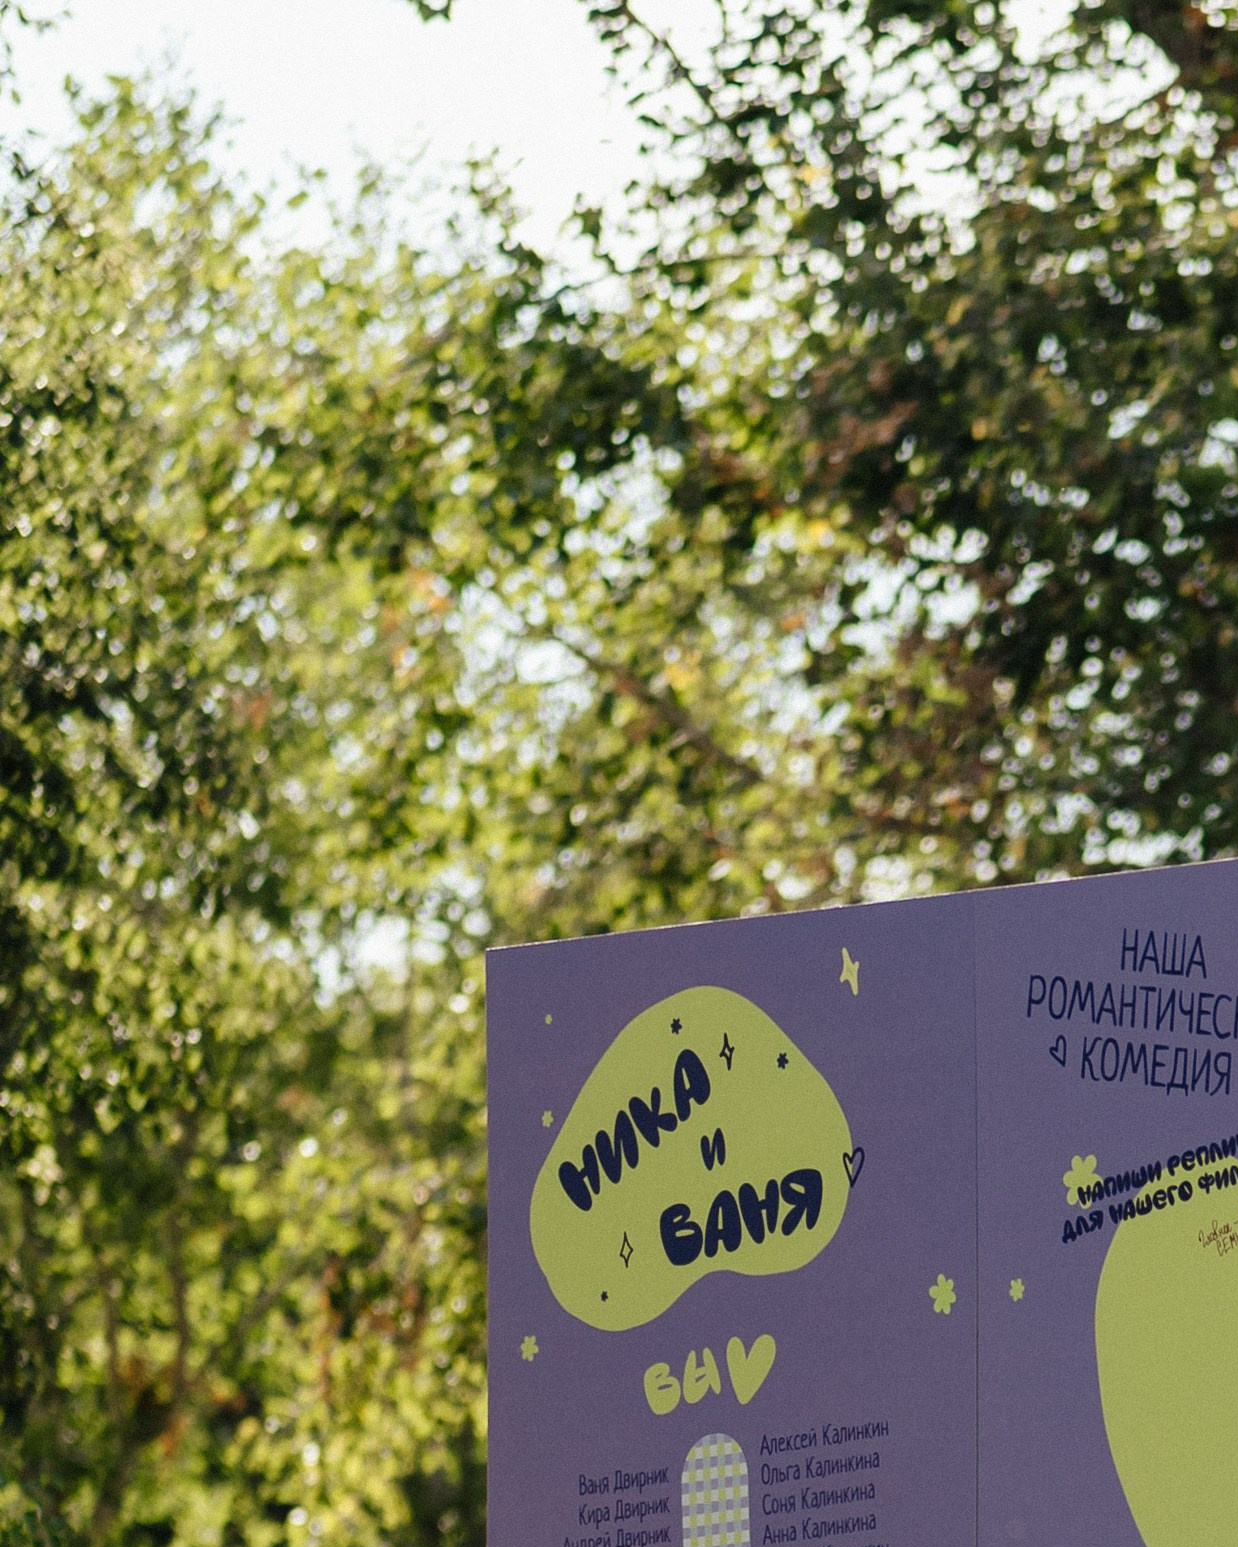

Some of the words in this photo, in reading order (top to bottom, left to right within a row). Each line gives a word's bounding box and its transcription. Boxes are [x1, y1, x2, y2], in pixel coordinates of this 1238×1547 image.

[1120, 927, 1207, 979] НАША
[1080, 1035, 1232, 1096] КОМЕДИЯ
[558, 1049, 711, 1212] НИКА
[1077, 1161, 1162, 1205] НАПИШИ
[659, 1168, 823, 1266] ВАНЯ
[1062, 1210, 1104, 1244] ДЛЯ
[1109, 1181, 1193, 1224] НАШЕГО
[643, 1346, 721, 1415] ВЫ
[760, 1428, 817, 1455] Алексей
[822, 1421, 889, 1446] Калинкин
[579, 1474, 609, 1495] Ваня
[613, 1467, 669, 1494] Двирник
[761, 1463, 800, 1485] Ольга
[806, 1452, 879, 1478] Калинкина
[579, 1504, 610, 1529] Кира
[615, 1497, 670, 1523] Двирник
[762, 1494, 796, 1515] Соня
[801, 1483, 875, 1509] Калинкина
[763, 1525, 796, 1545] Анна
[802, 1514, 876, 1540] Калинкина
